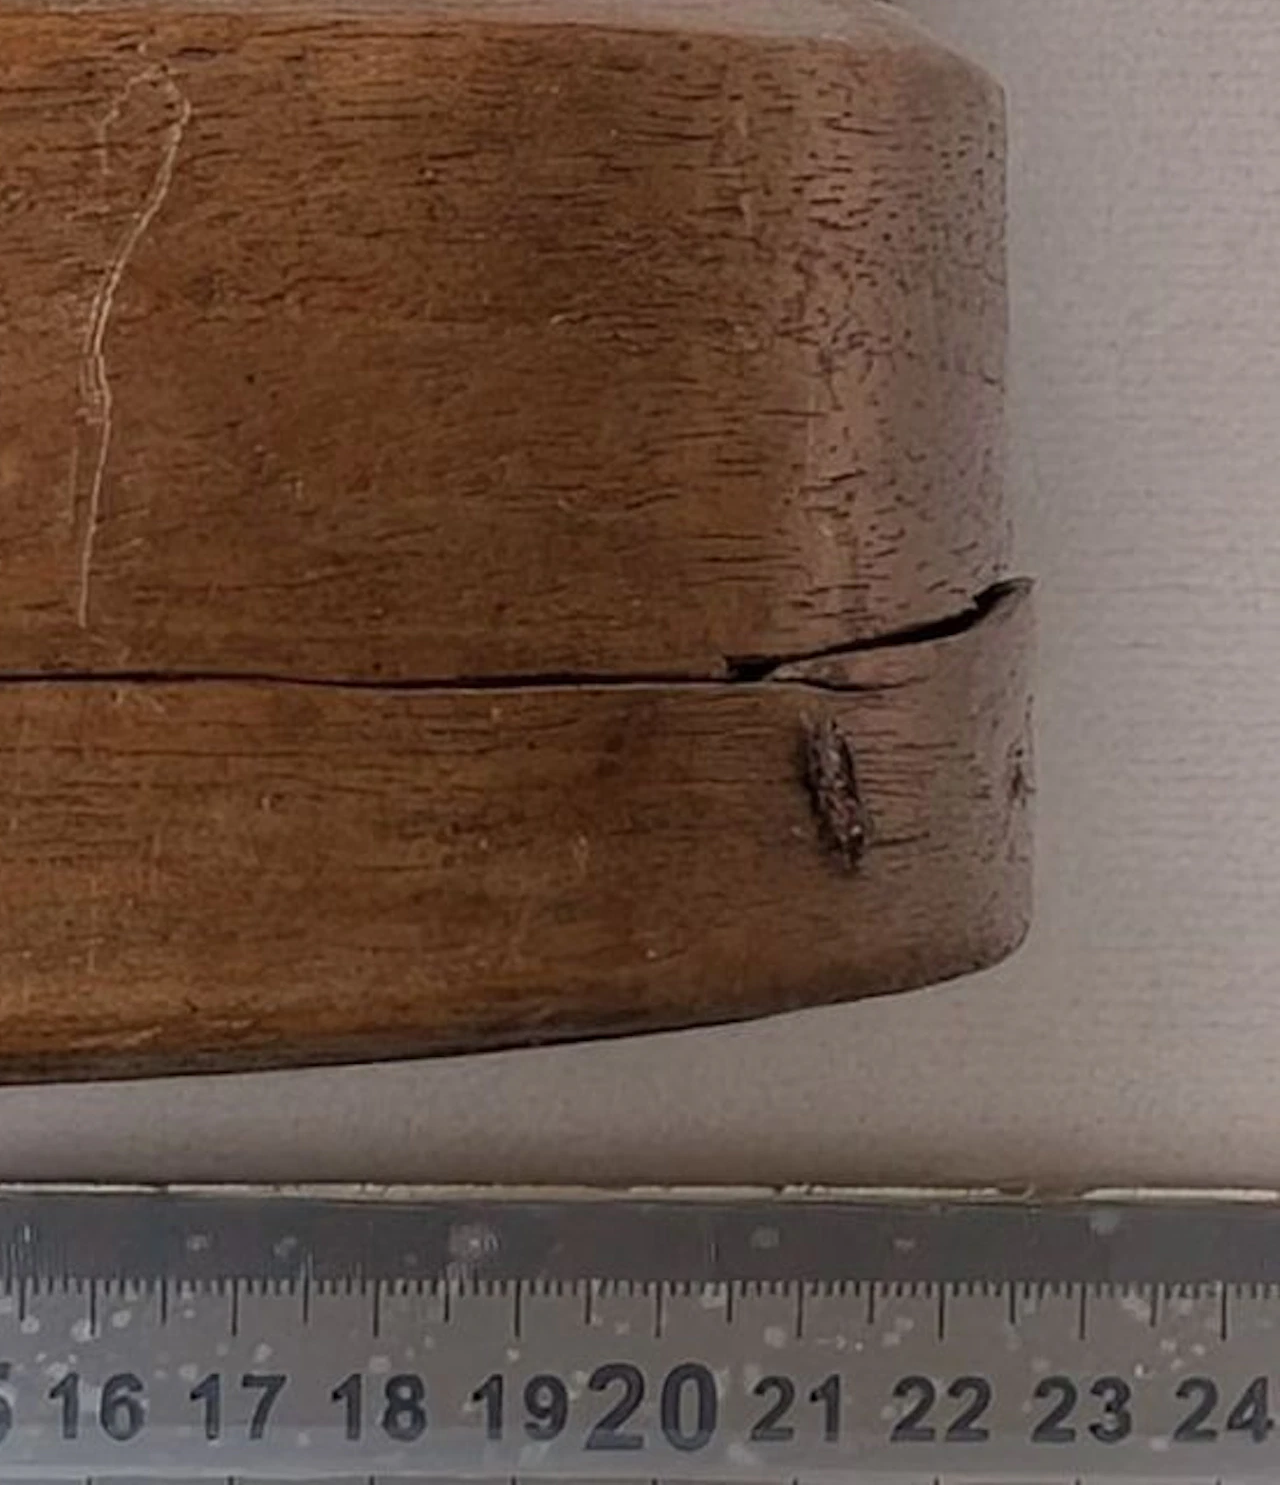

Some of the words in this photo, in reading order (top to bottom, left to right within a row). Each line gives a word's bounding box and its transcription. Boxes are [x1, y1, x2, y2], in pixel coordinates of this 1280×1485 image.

[48, 1371, 145, 1442] 16
[189, 1372, 287, 1441] 17
[330, 1373, 427, 1442] 18
[471, 1373, 569, 1440] 19
[584, 1362, 718, 1452] 20
[750, 1373, 841, 1442] 21
[889, 1375, 992, 1443] 22
[1031, 1375, 1132, 1444] 23
[1173, 1375, 1275, 1444] 24
